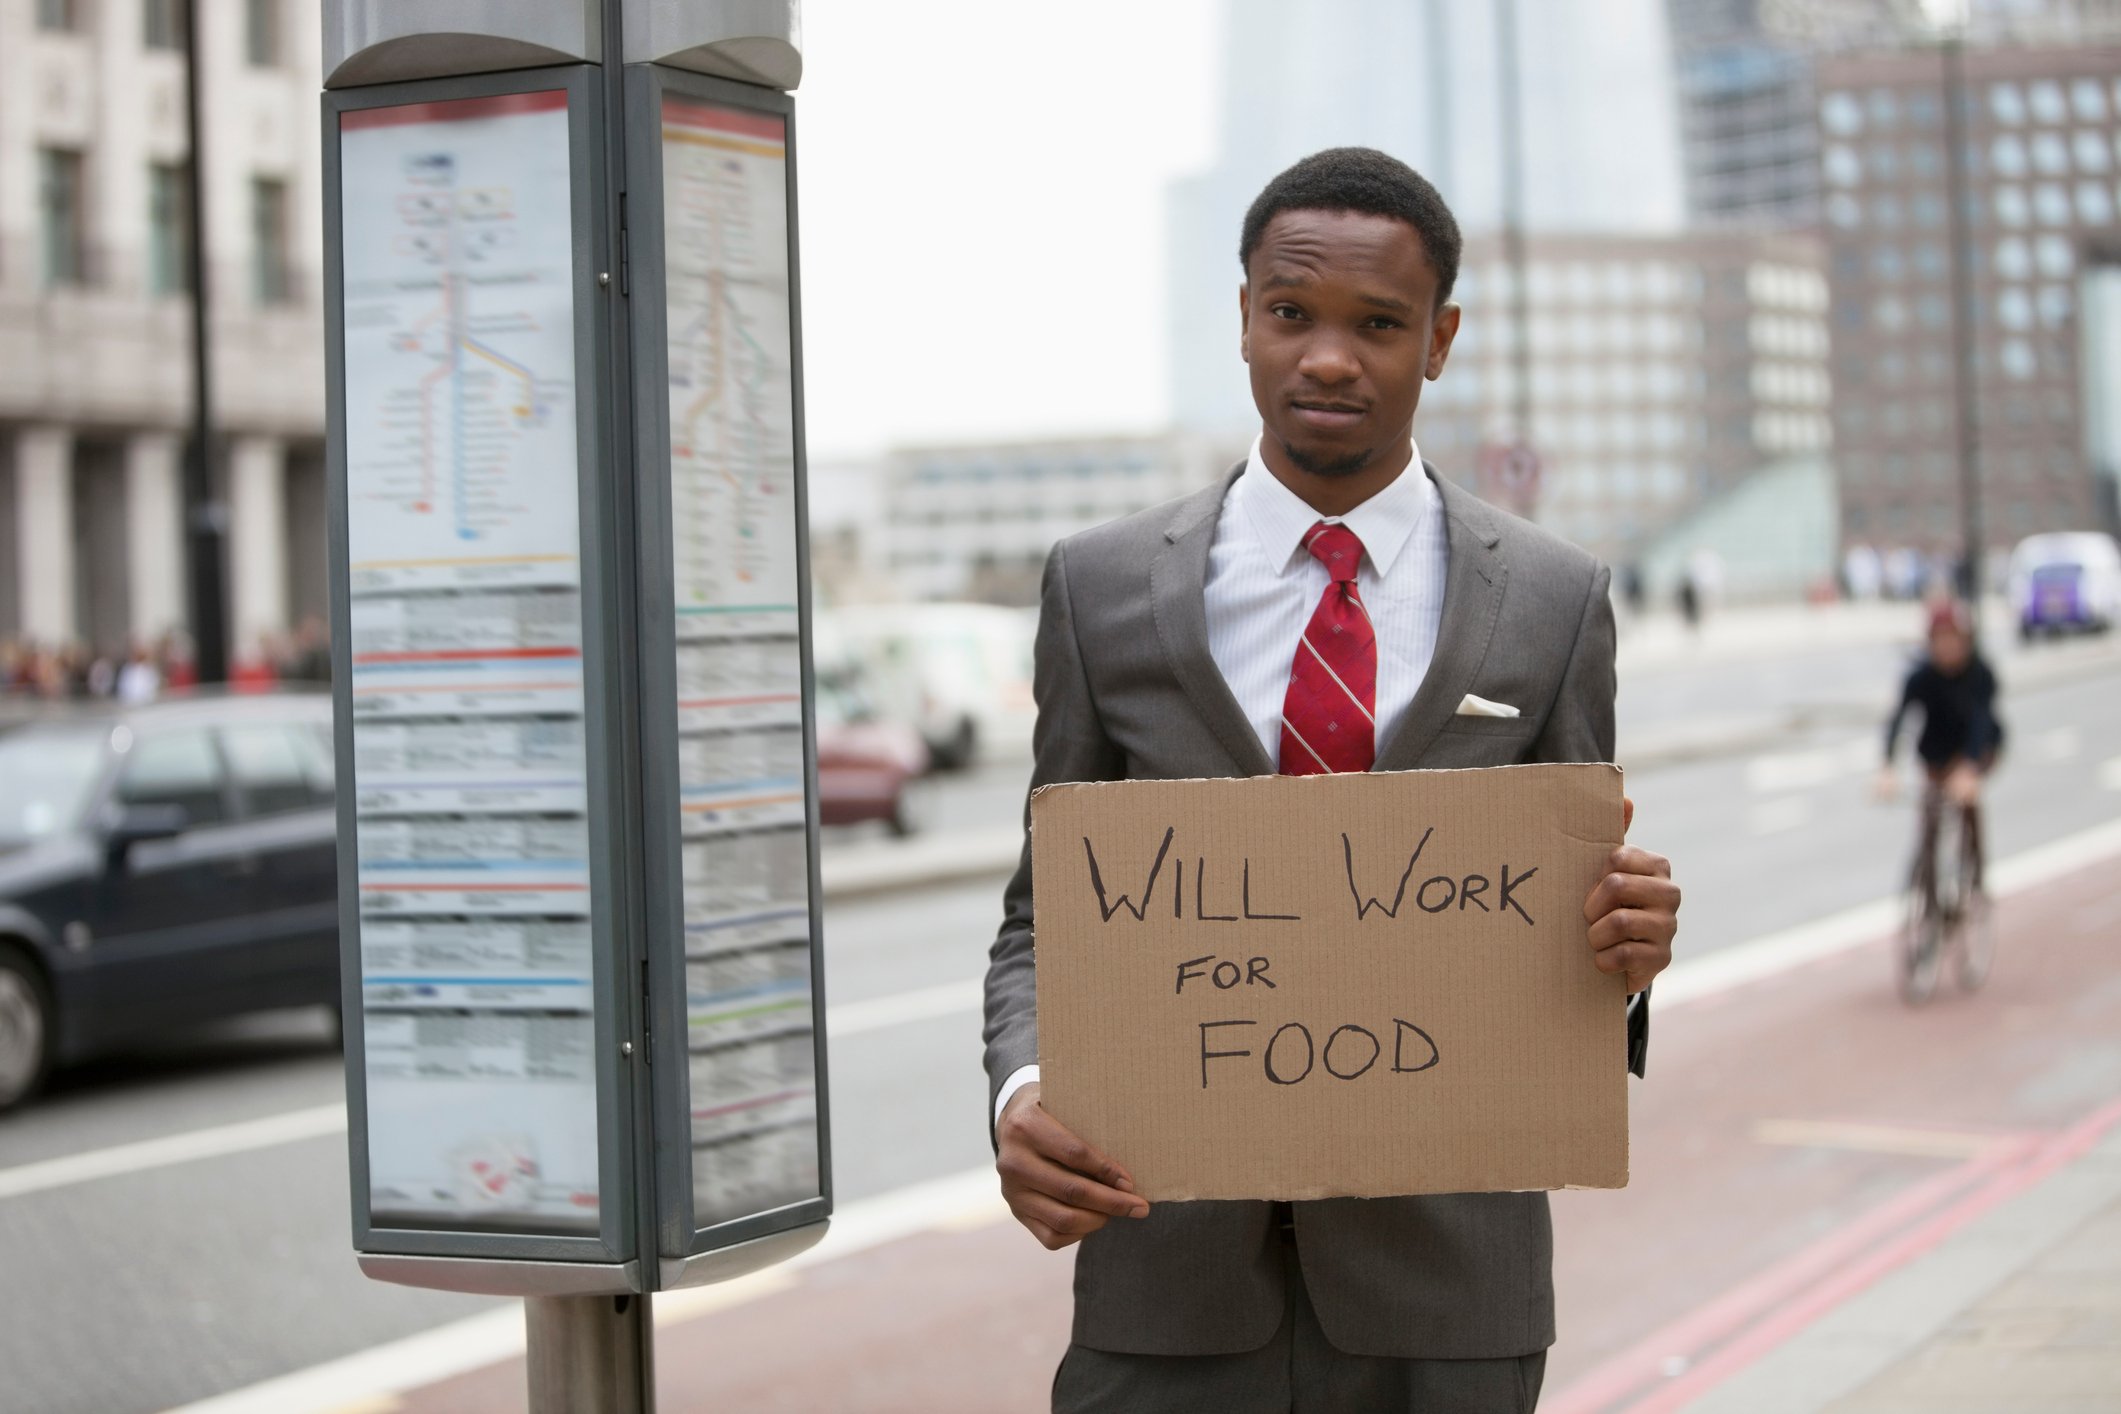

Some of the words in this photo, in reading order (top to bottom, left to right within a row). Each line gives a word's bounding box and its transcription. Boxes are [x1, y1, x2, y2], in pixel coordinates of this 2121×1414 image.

[1082, 825, 1301, 923] WILL
[1341, 826, 1539, 926] WORK
[1175, 954, 1277, 995] FOR
[1197, 1017, 1441, 1089] FOOD
